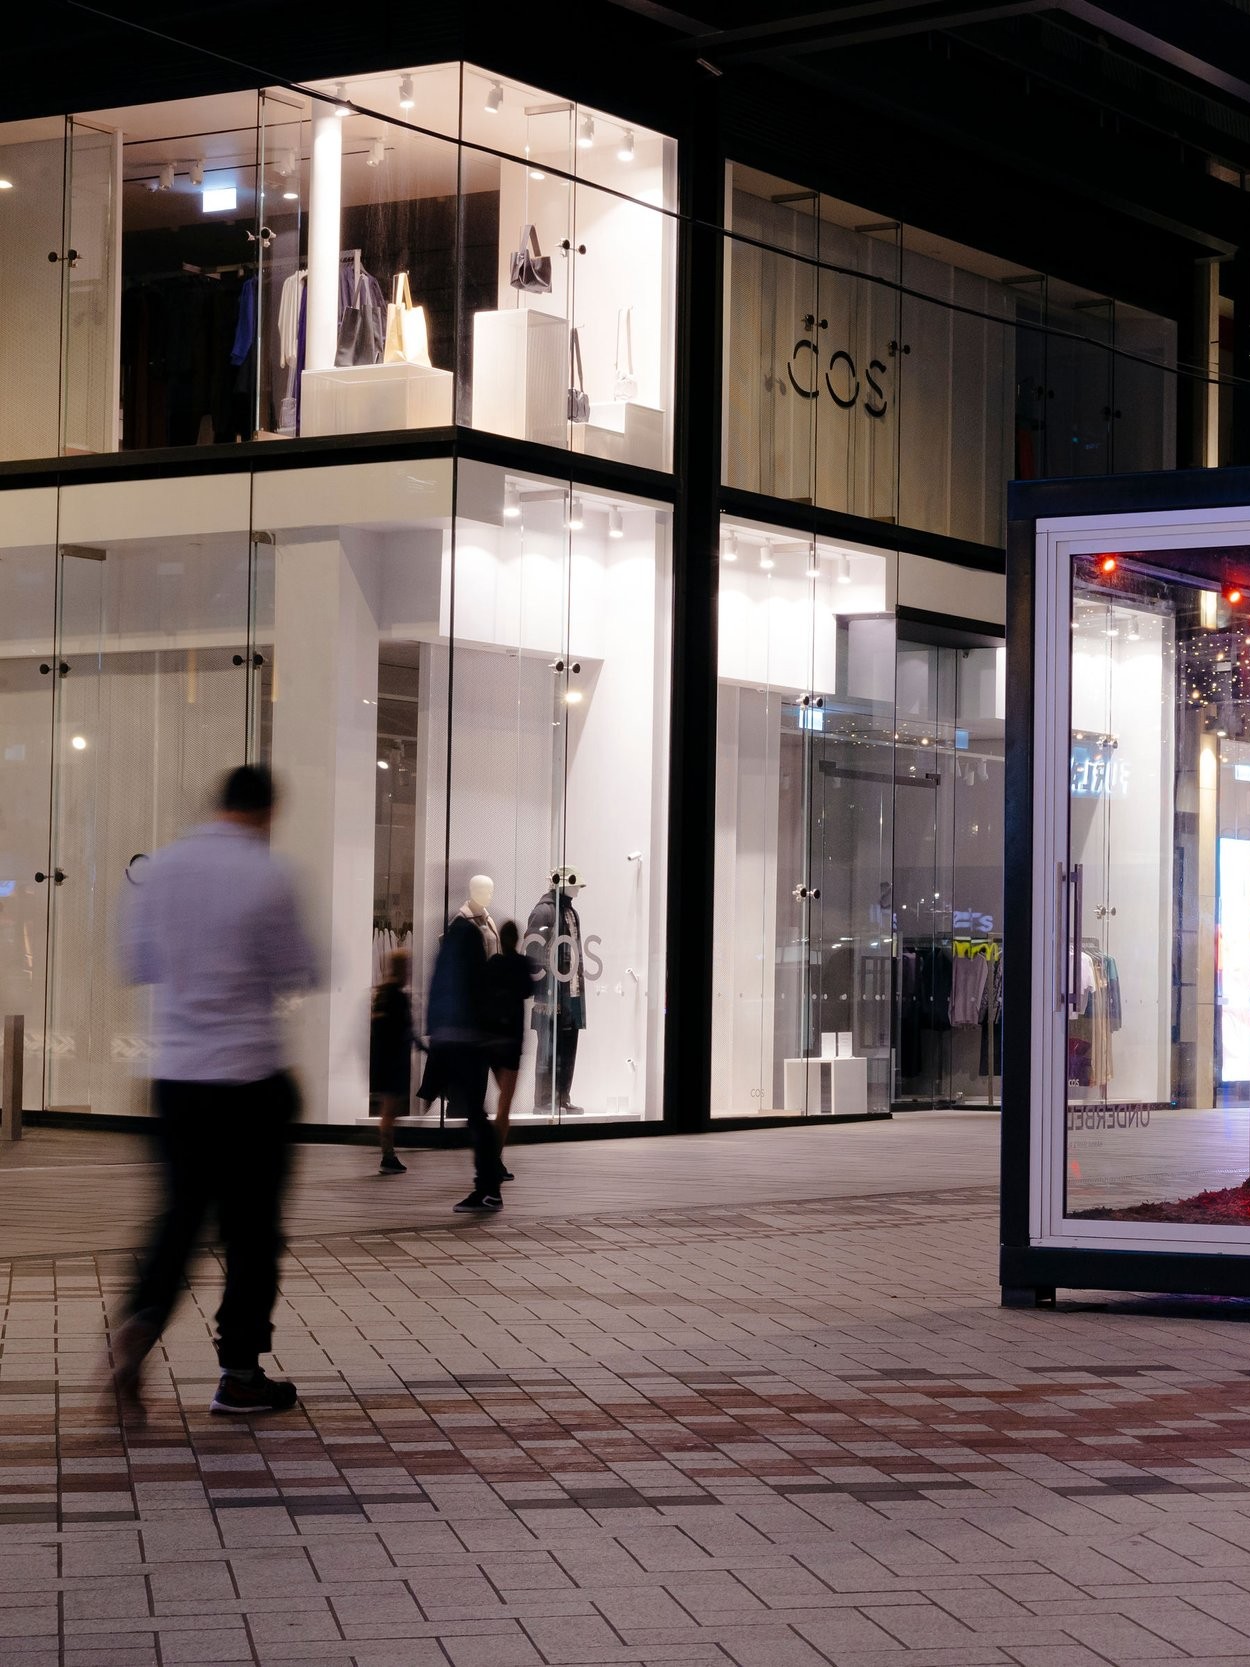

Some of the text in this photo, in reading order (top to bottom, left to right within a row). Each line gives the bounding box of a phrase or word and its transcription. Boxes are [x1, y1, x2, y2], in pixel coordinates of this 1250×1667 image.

[787, 339, 887, 418] COS
[523, 933, 604, 983] COS
[750, 1088, 765, 1097] COS
